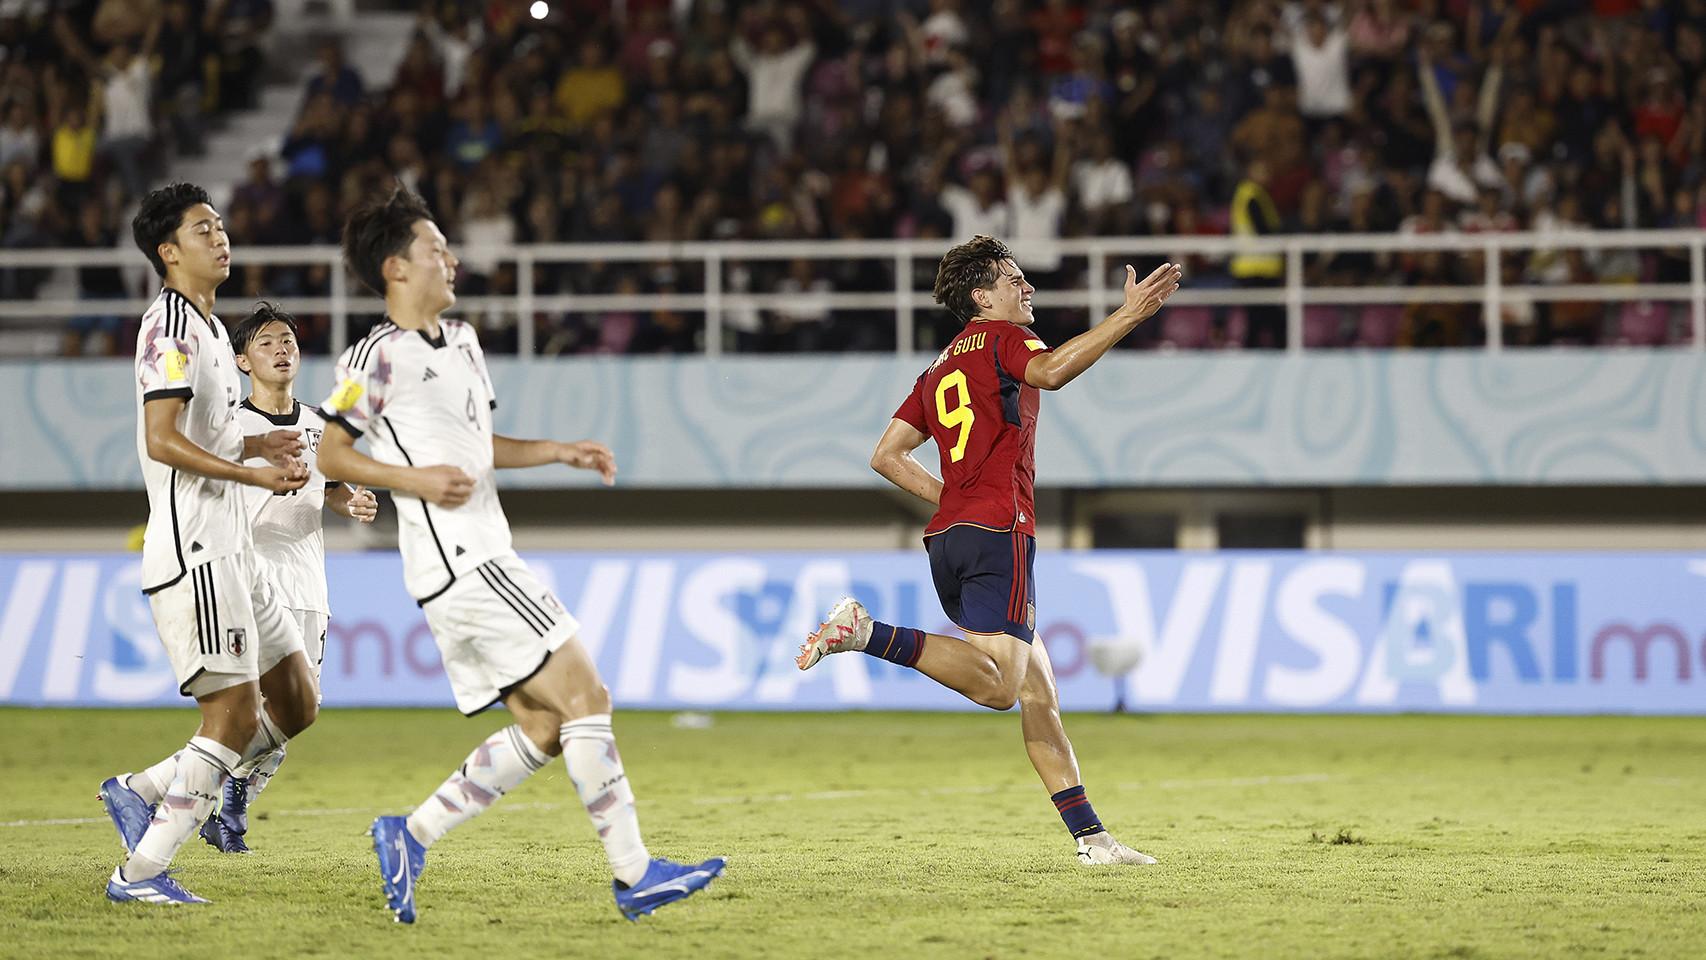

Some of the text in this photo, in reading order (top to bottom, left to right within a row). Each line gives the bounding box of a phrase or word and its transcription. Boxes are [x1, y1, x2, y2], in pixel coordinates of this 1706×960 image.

[953, 331, 987, 356] GUIU
[935, 368, 976, 463] 9
[520, 558, 875, 702] VISA
[1072, 558, 1478, 703] VISA
